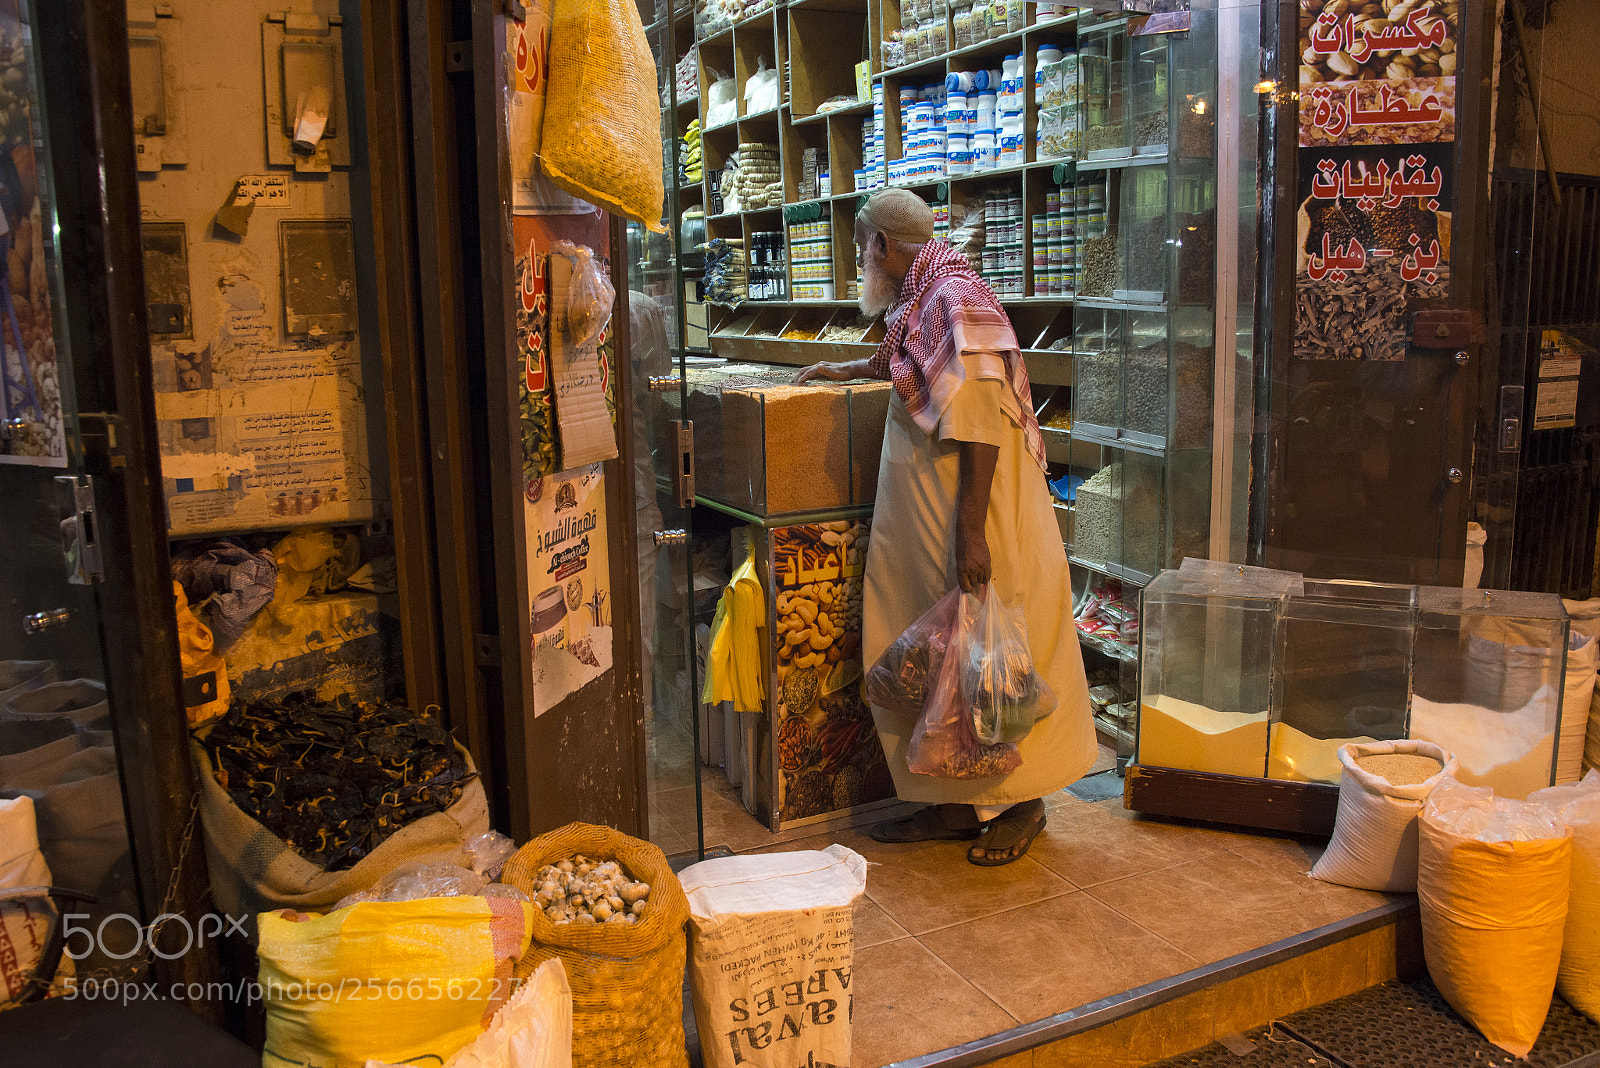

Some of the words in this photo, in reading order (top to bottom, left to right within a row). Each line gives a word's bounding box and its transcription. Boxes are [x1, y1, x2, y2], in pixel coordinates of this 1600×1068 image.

[1311, 5, 1447, 64] مكسرات
[1311, 83, 1443, 137] عطارة
[1311, 153, 1443, 212] بقوليات
[1307, 231, 1367, 284] هيل
[1400, 232, 1441, 285] بن
[536, 515, 571, 559] الشيوخ
[571, 508, 597, 540] قهوة
[720, 953, 762, 974] PACKED)
[763, 938, 799, 957] (WHEN
